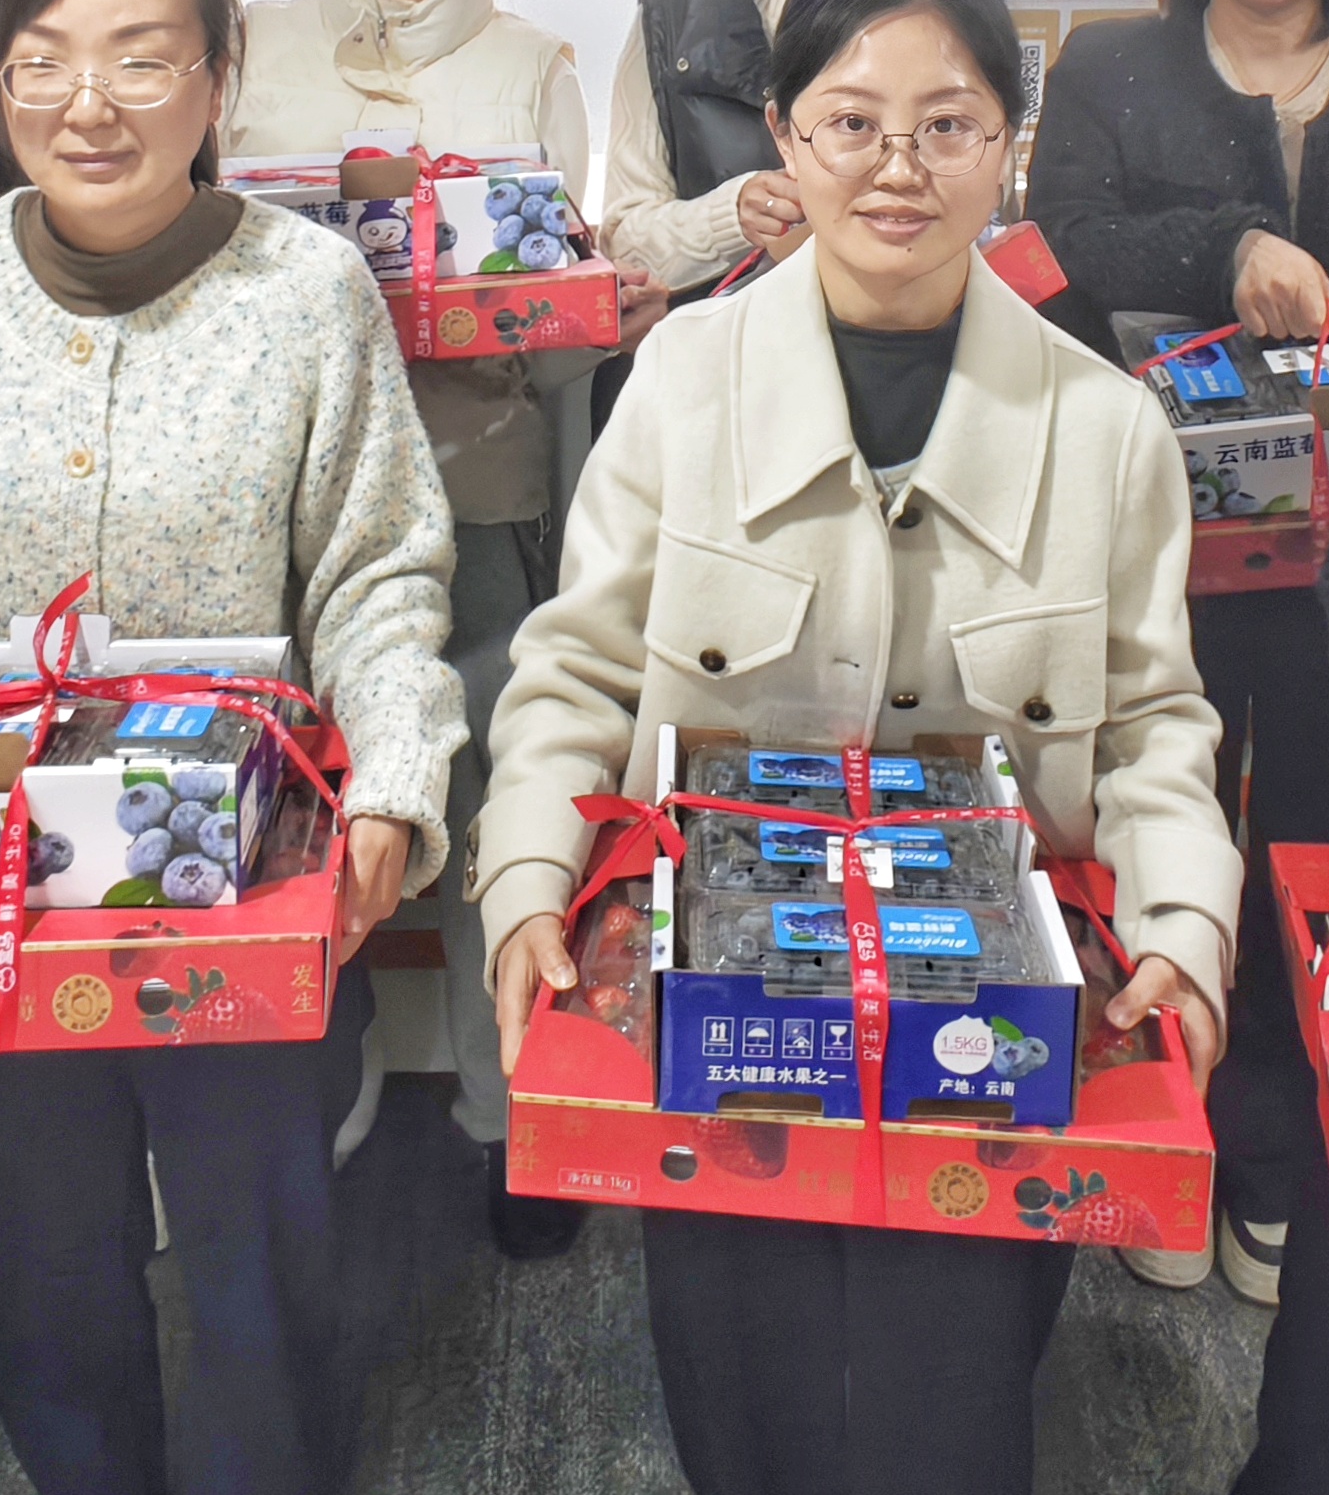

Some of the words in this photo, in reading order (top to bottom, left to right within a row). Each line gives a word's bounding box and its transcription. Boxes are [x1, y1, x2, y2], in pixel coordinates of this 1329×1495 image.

[706, 1064, 848, 1086] 五大健康水果之一
